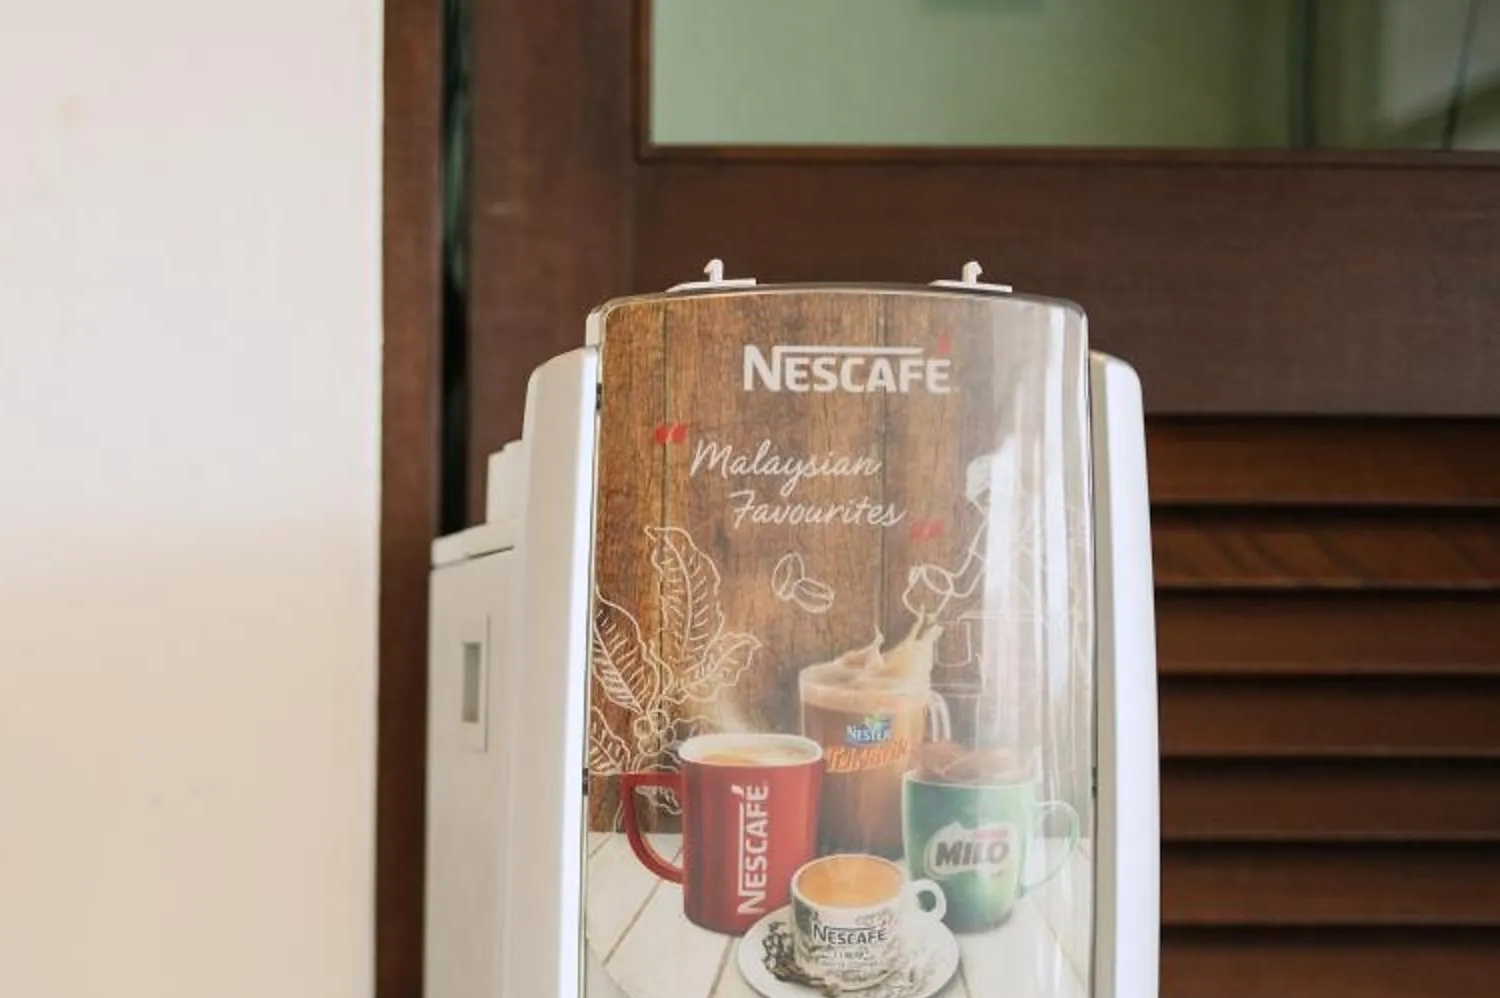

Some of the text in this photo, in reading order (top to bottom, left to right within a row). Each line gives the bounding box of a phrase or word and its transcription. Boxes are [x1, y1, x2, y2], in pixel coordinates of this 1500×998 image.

[689, 439, 882, 497] Malaysian
[729, 490, 907, 530] Favourites
[934, 840, 1010, 867] MILO
